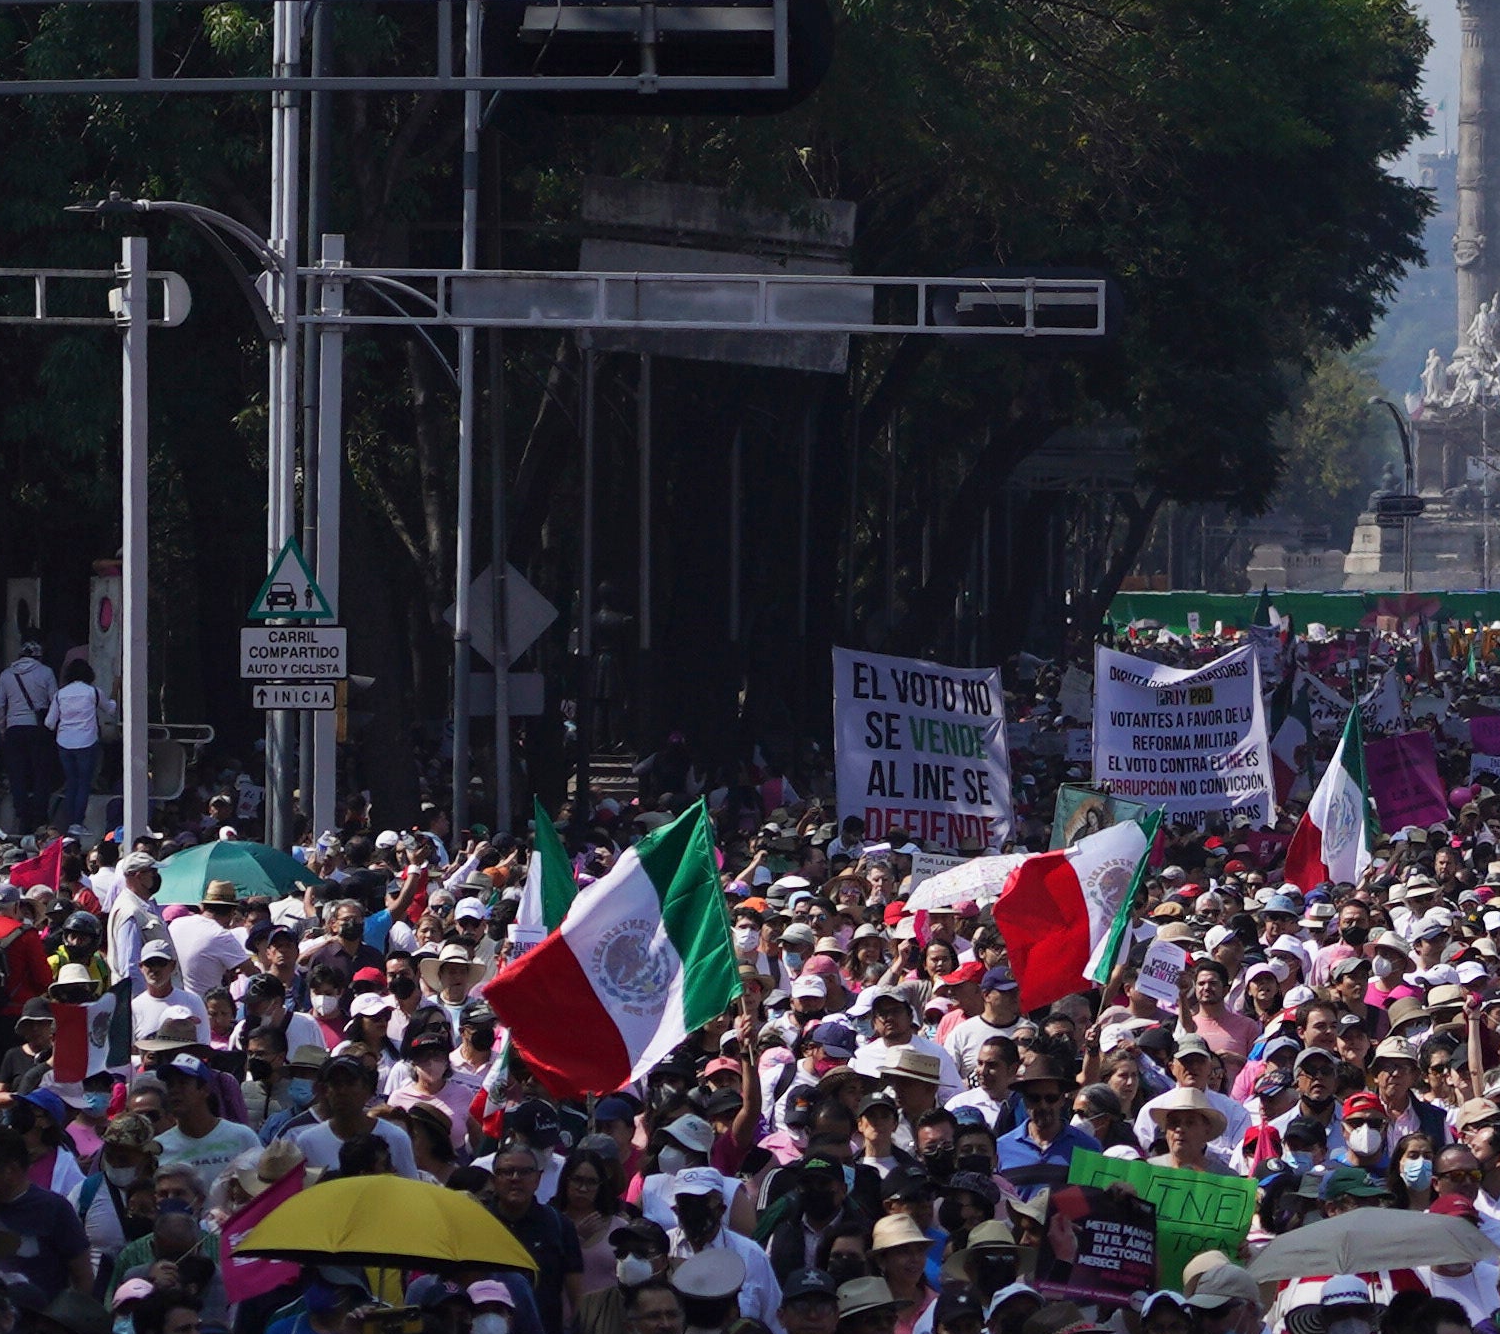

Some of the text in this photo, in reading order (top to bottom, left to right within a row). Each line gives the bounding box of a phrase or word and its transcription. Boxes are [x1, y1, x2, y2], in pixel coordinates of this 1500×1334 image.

[269, 632, 318, 644] CARRIL
[249, 646, 339, 659] COMPARTIDO
[247, 664, 340, 674] AUTO Y CICLISTA
[274, 690, 331, 703] INICIA
[853, 662, 992, 716] EL VOTO NO
[1189, 686, 1214, 705] PRD
[1110, 707, 1252, 728] VOTANTES A FAVOR DE LA
[866, 711, 986, 760] SE VENDE
[1133, 731, 1238, 751] REFORMA MILITAR
[1108, 751, 1259, 773] EL VOTO CONTRA EL INE ES
[867, 761, 992, 805] AL INE SE
[1102, 773, 1268, 796] CORRUPCIÓN NO CONVICCIÓN.
[864, 807, 996, 848] DEFIENDE
[919, 857, 934, 865] POR
[1156, 1183, 1241, 1226] INE
[1085, 1219, 1155, 1241] METER MANO
[1093, 1233, 1108, 1245] EN
[1111, 1234, 1123, 1246] EL
[1171, 1231, 1231, 1256] TOCA
[1077, 1254, 1121, 1271] MERECE
[1091, 1244, 1155, 1266] ELECTORAL
